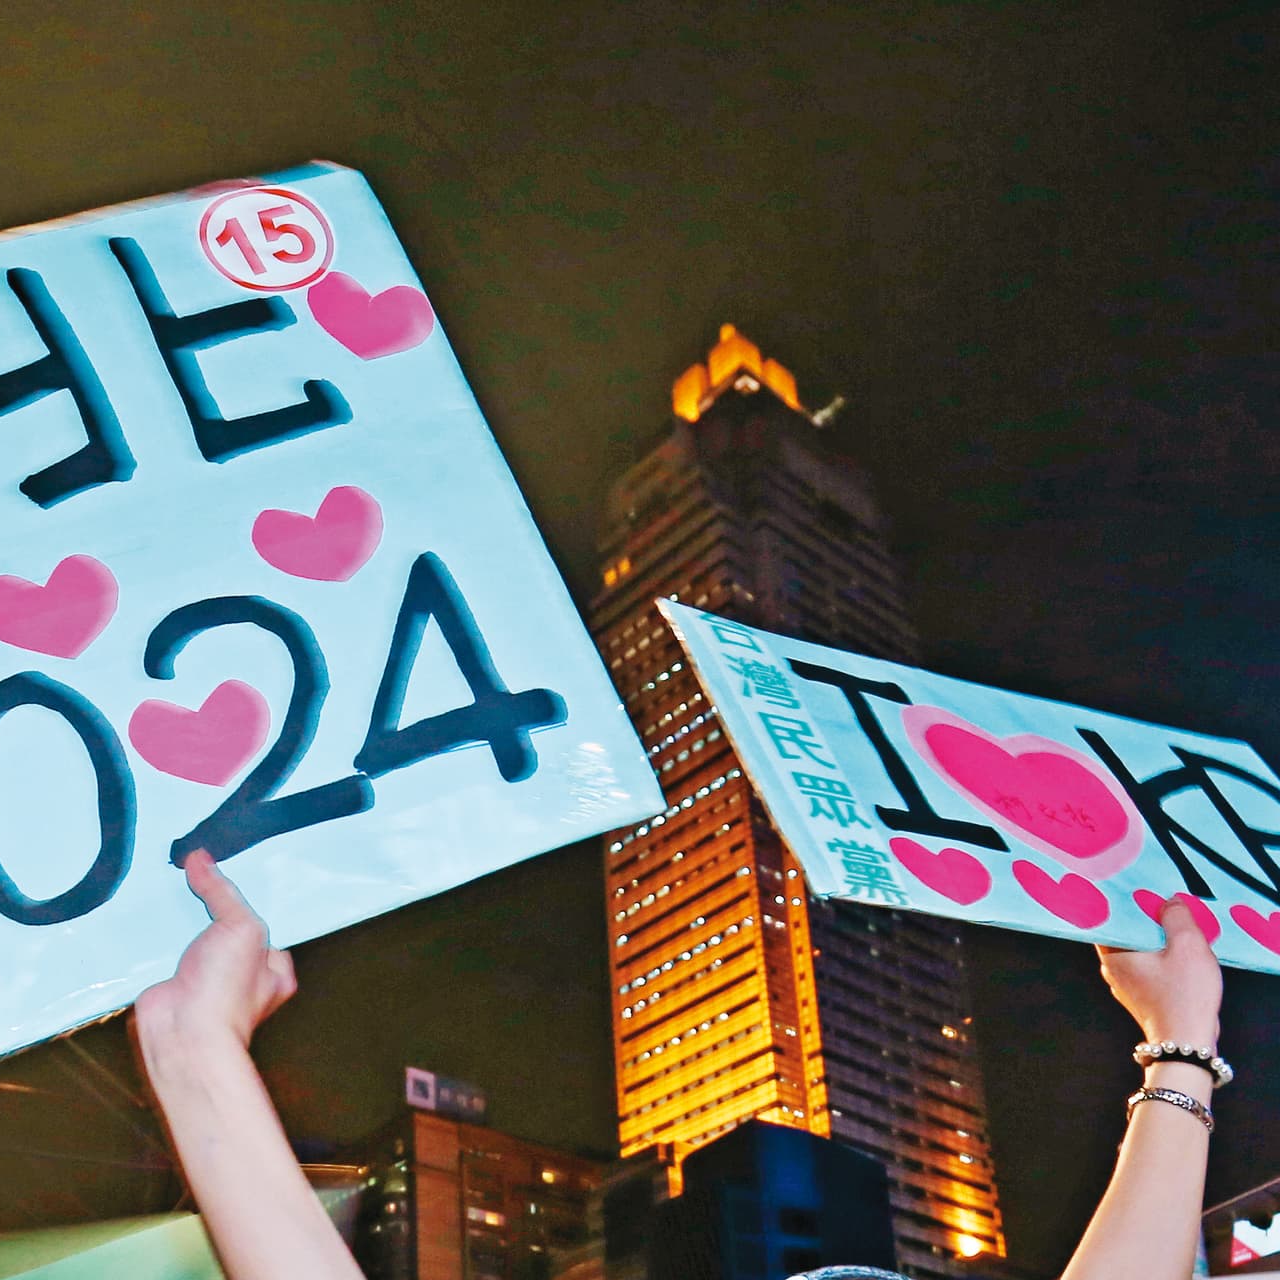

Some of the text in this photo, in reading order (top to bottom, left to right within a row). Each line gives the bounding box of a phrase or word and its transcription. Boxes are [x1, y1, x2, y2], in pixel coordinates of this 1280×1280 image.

[216, 204, 316, 276] 15
[699, 612, 909, 906] 台灣民眾黨
[786, 657, 1010, 851] I
